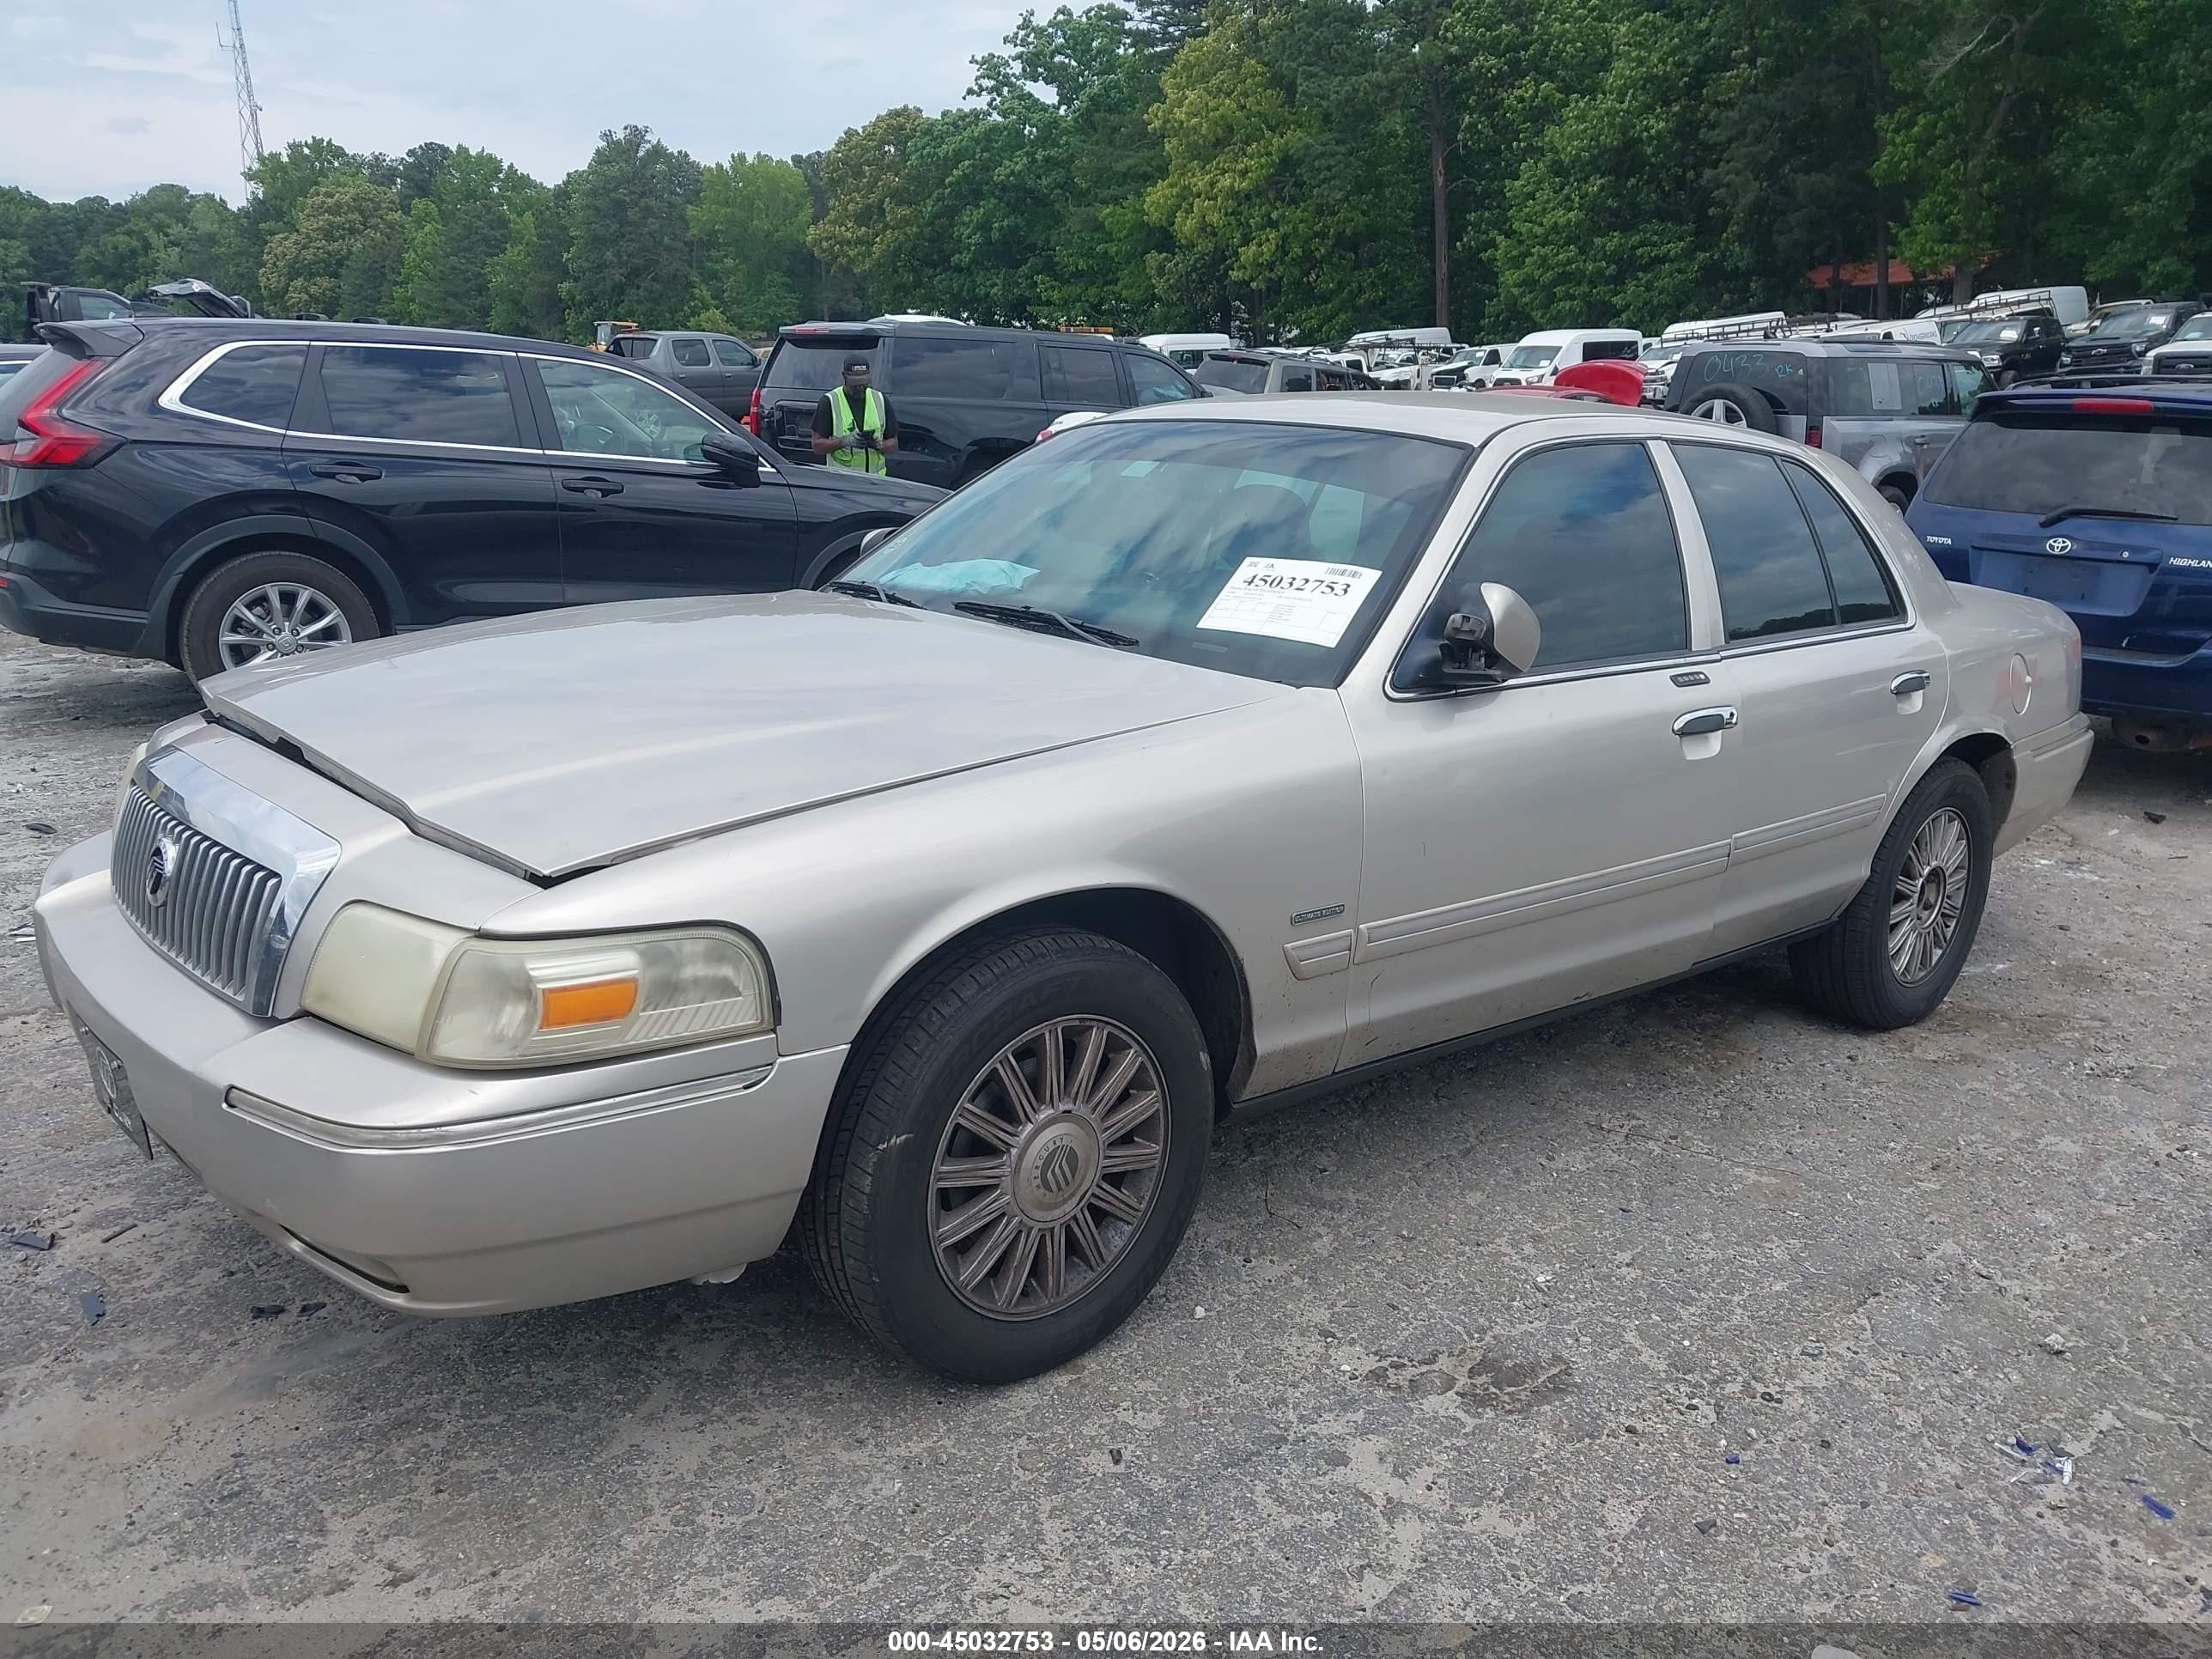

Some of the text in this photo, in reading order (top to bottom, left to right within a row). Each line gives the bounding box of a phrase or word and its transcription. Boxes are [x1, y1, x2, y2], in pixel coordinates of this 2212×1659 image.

[1926, 535, 1952, 545] TOYOTA
[1243, 573, 1352, 598] 45032753
[1033, 1135, 1065, 1190] MERCURY
